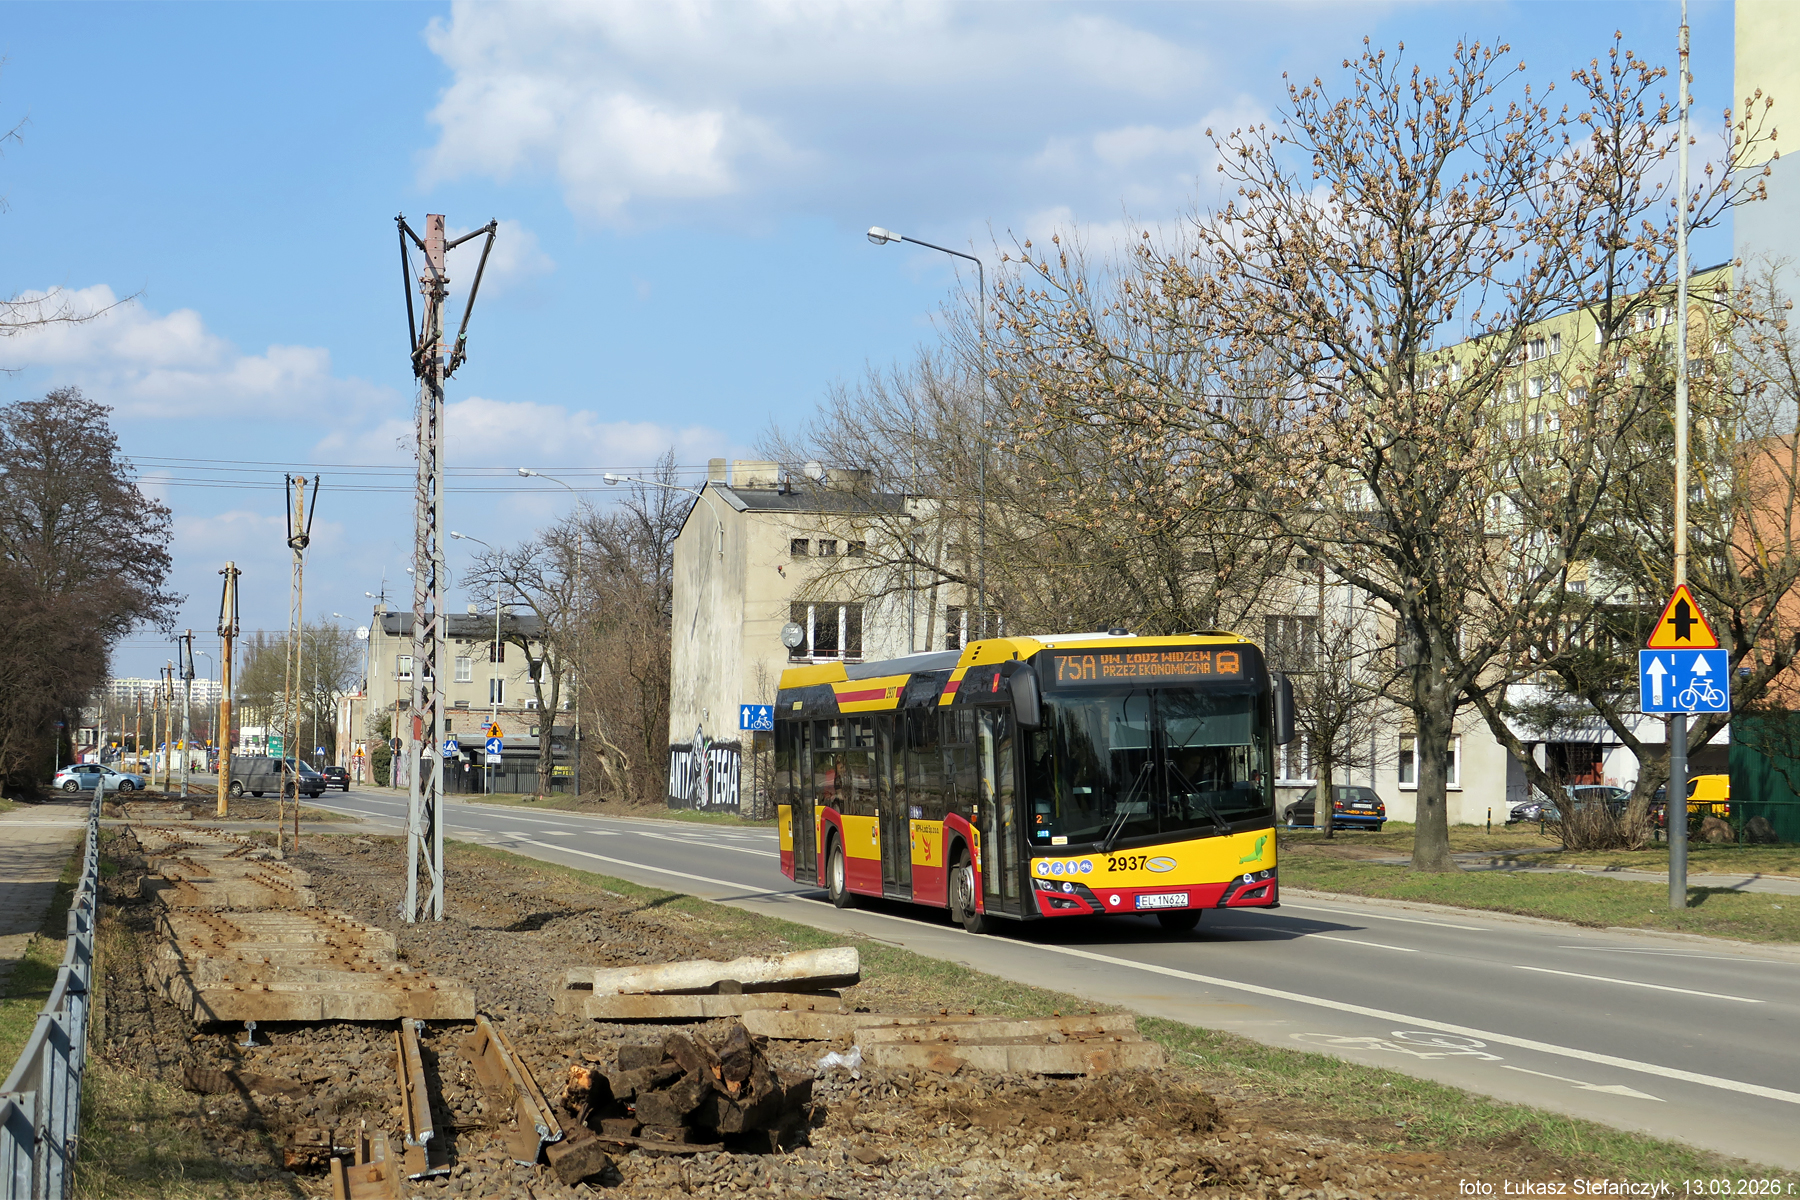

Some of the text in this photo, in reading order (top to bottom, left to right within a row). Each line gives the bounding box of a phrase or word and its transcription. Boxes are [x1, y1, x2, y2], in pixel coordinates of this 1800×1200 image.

[1100, 654, 1123, 664] DW.
[1161, 651, 1211, 662] WIDZEW
[1054, 655, 1096, 680] 75A
[1103, 662, 1211, 677] PRZEZ EKONOMICZNA
[1108, 855, 1147, 872] 2937
[1141, 894, 1186, 906] EL 1N622
